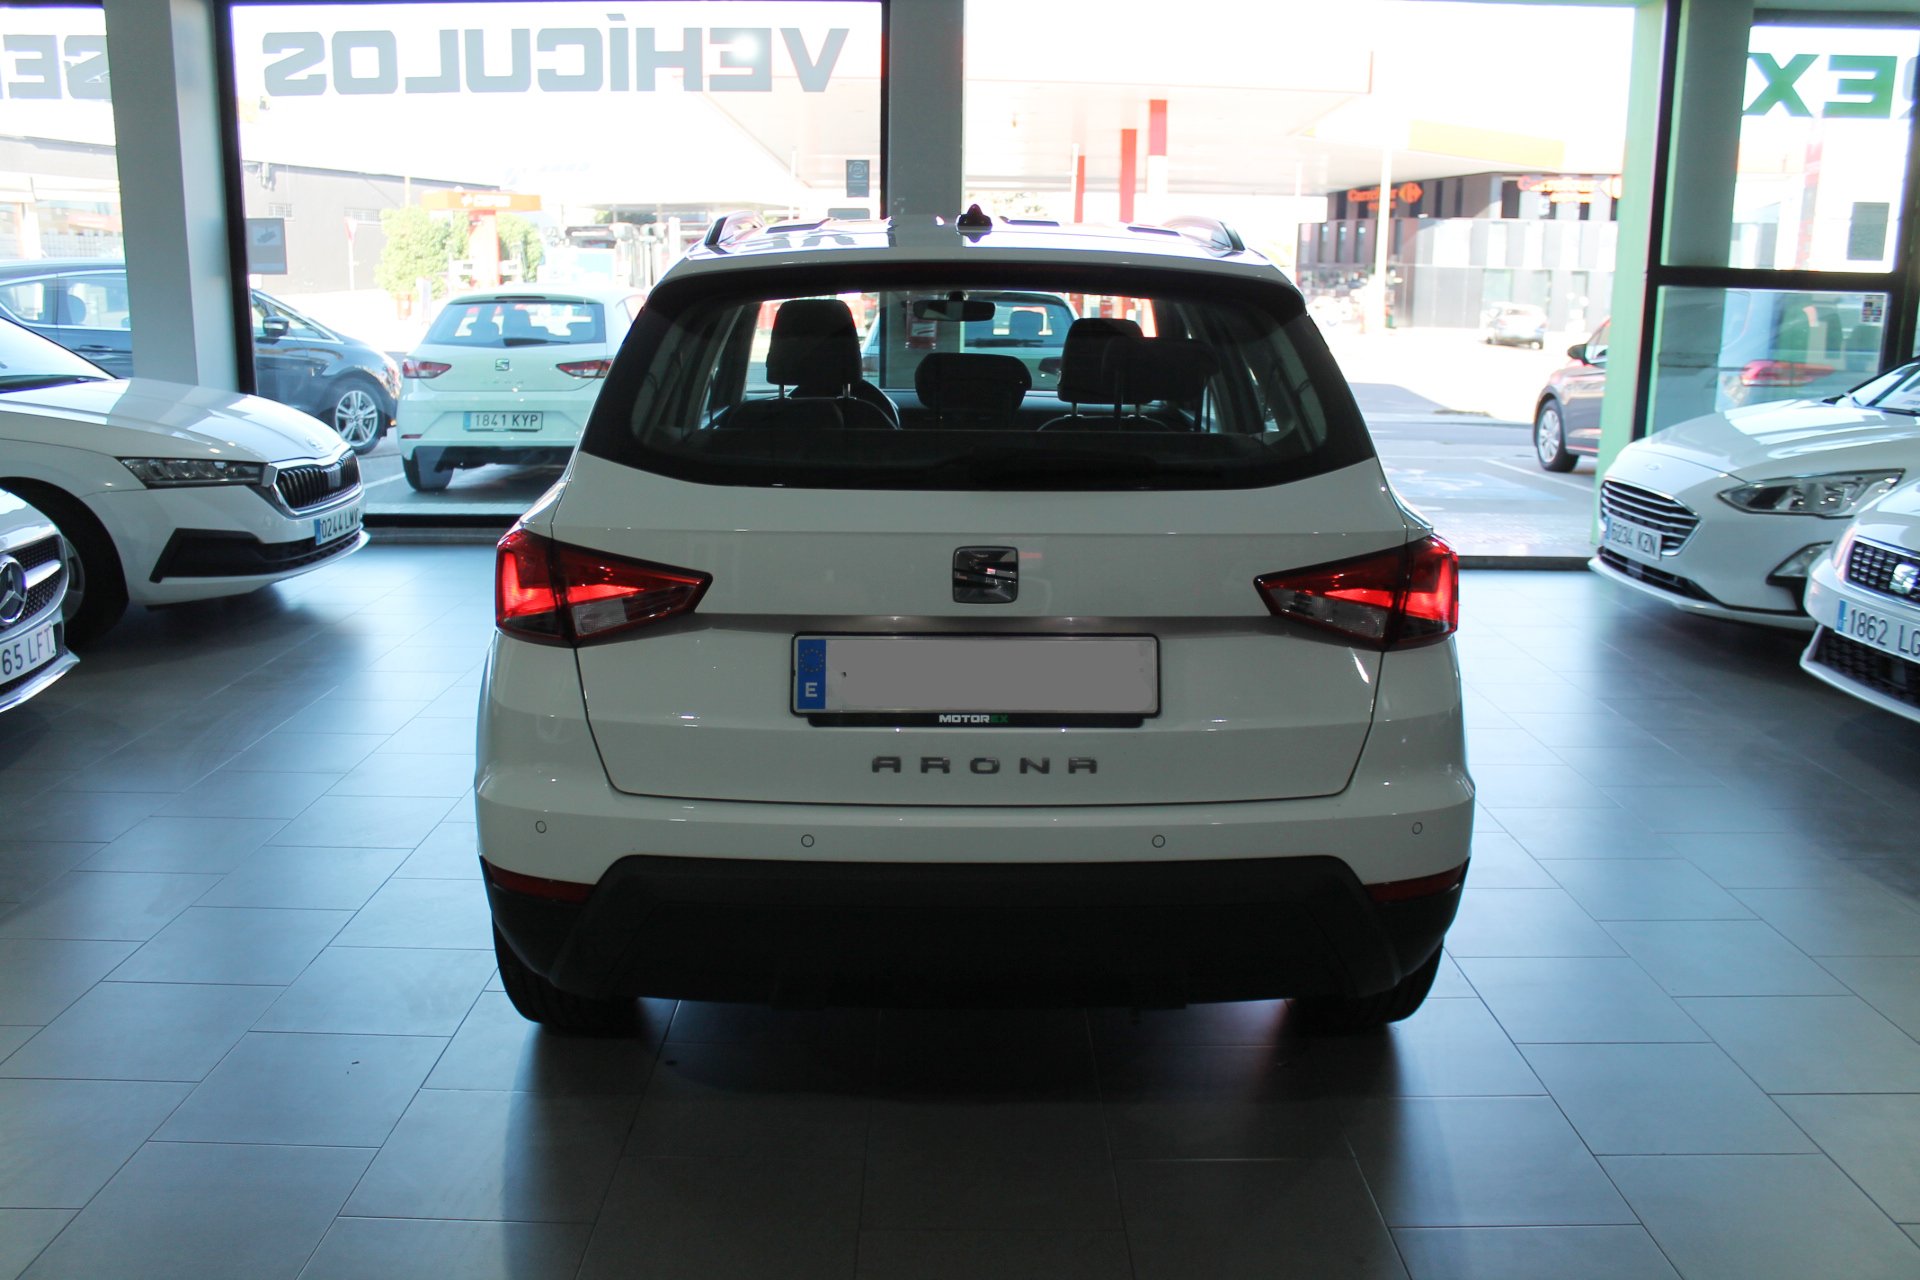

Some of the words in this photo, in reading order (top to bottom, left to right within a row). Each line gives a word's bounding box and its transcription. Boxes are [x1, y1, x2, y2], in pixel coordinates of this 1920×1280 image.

[475, 414, 506, 427] 1841
[511, 414, 539, 427] KYP
[321, 513, 343, 539] 0244
[1850, 608, 1888, 646] 1862
[28, 627, 51, 664] LFT
[805, 682, 818, 698] E
[939, 714, 1008, 724] MOTOREX
[872, 756, 1098, 775] ARONA
